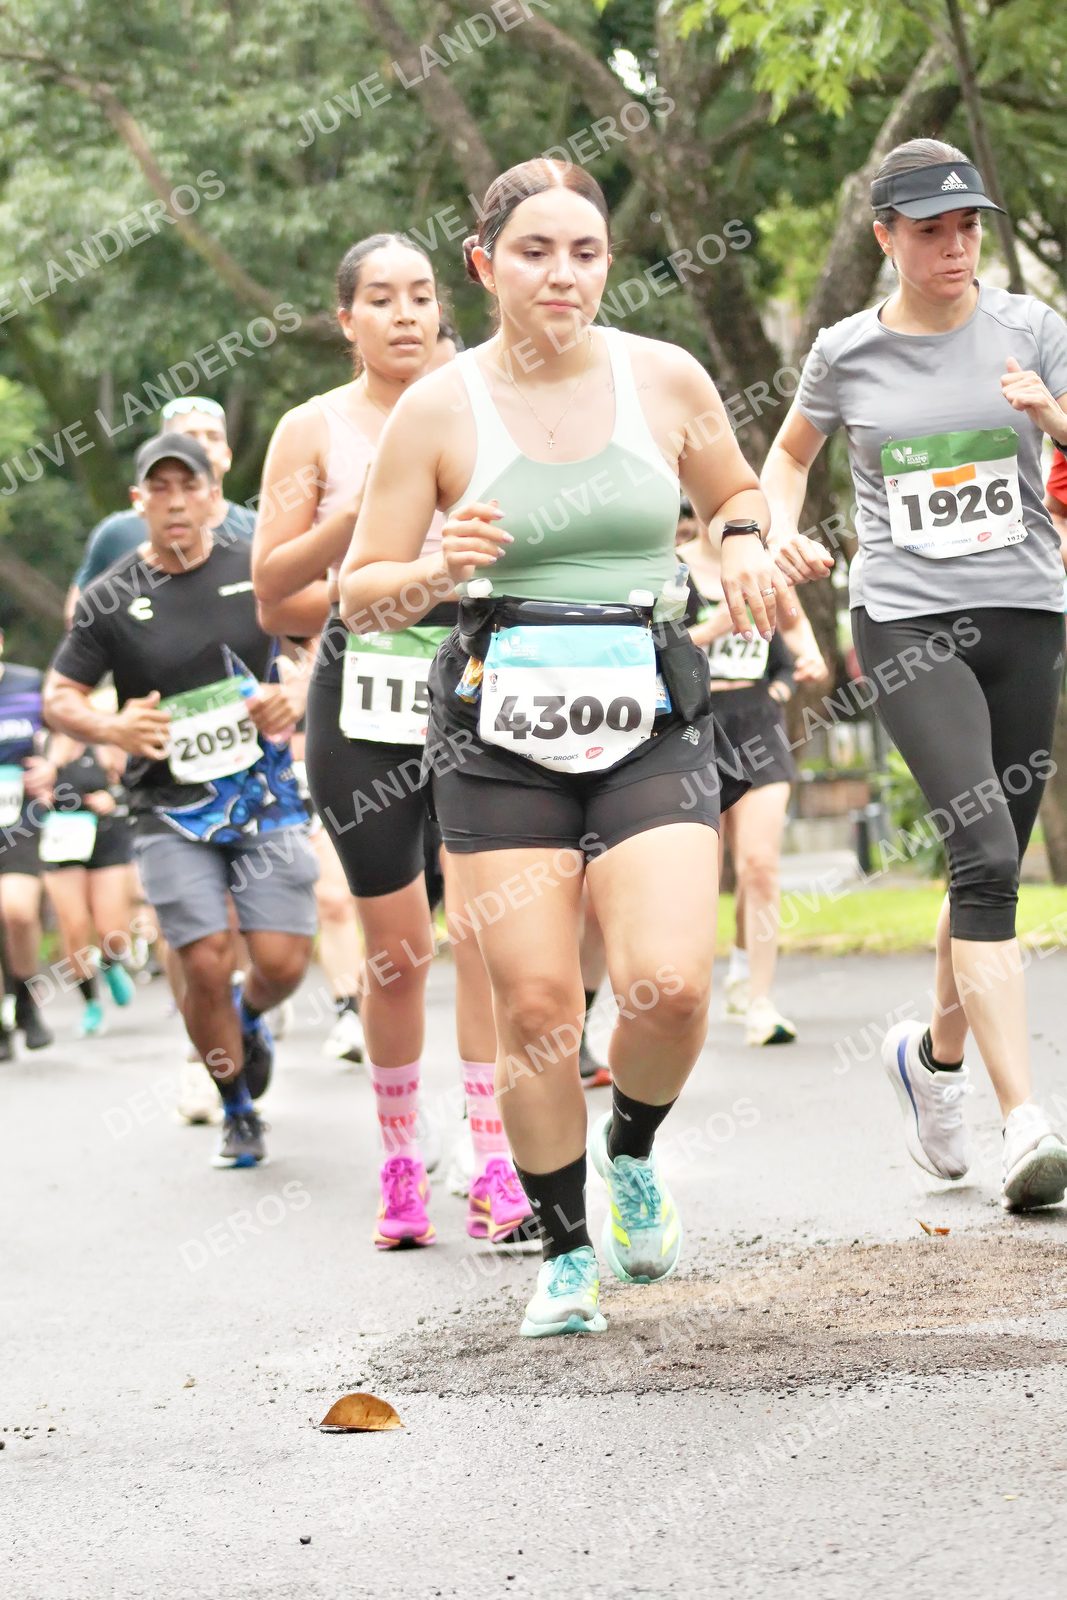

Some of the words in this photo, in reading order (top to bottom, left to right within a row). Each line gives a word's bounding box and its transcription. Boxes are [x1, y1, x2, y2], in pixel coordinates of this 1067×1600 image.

[901, 478, 1014, 531] 1926
[174, 717, 254, 762] 2095
[494, 695, 642, 740] 4300
